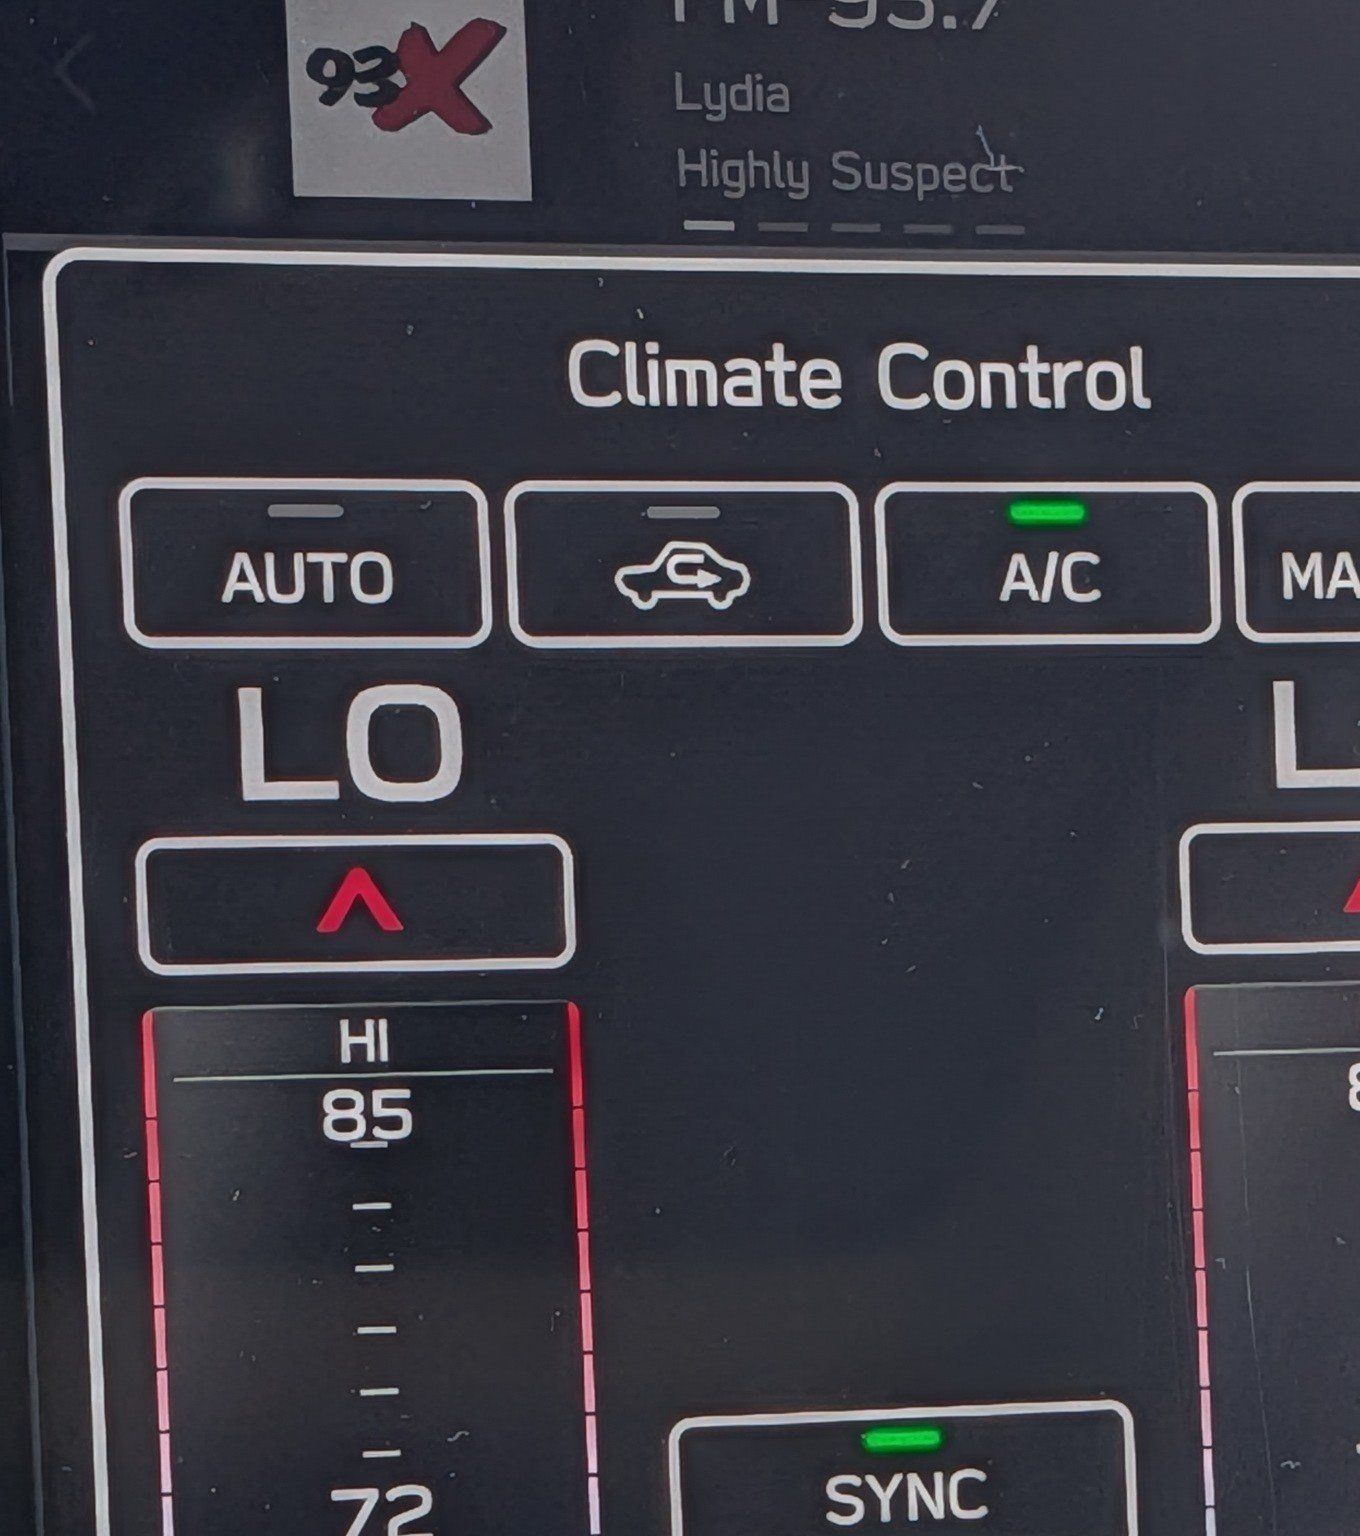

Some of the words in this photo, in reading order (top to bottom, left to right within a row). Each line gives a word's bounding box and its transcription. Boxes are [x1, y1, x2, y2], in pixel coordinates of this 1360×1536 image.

[673, 70, 790, 122] Lydia
[676, 147, 810, 200] Highly
[830, 150, 1015, 201] Suspect
[567, 338, 843, 409] Climate
[876, 341, 1152, 411] Control
[220, 550, 395, 605] AUTO
[998, 550, 1102, 605] A/C
[236, 682, 464, 803] LO
[338, 1017, 389, 1064] HI
[321, 1088, 413, 1142] 85
[822, 1465, 990, 1527] SYNC
